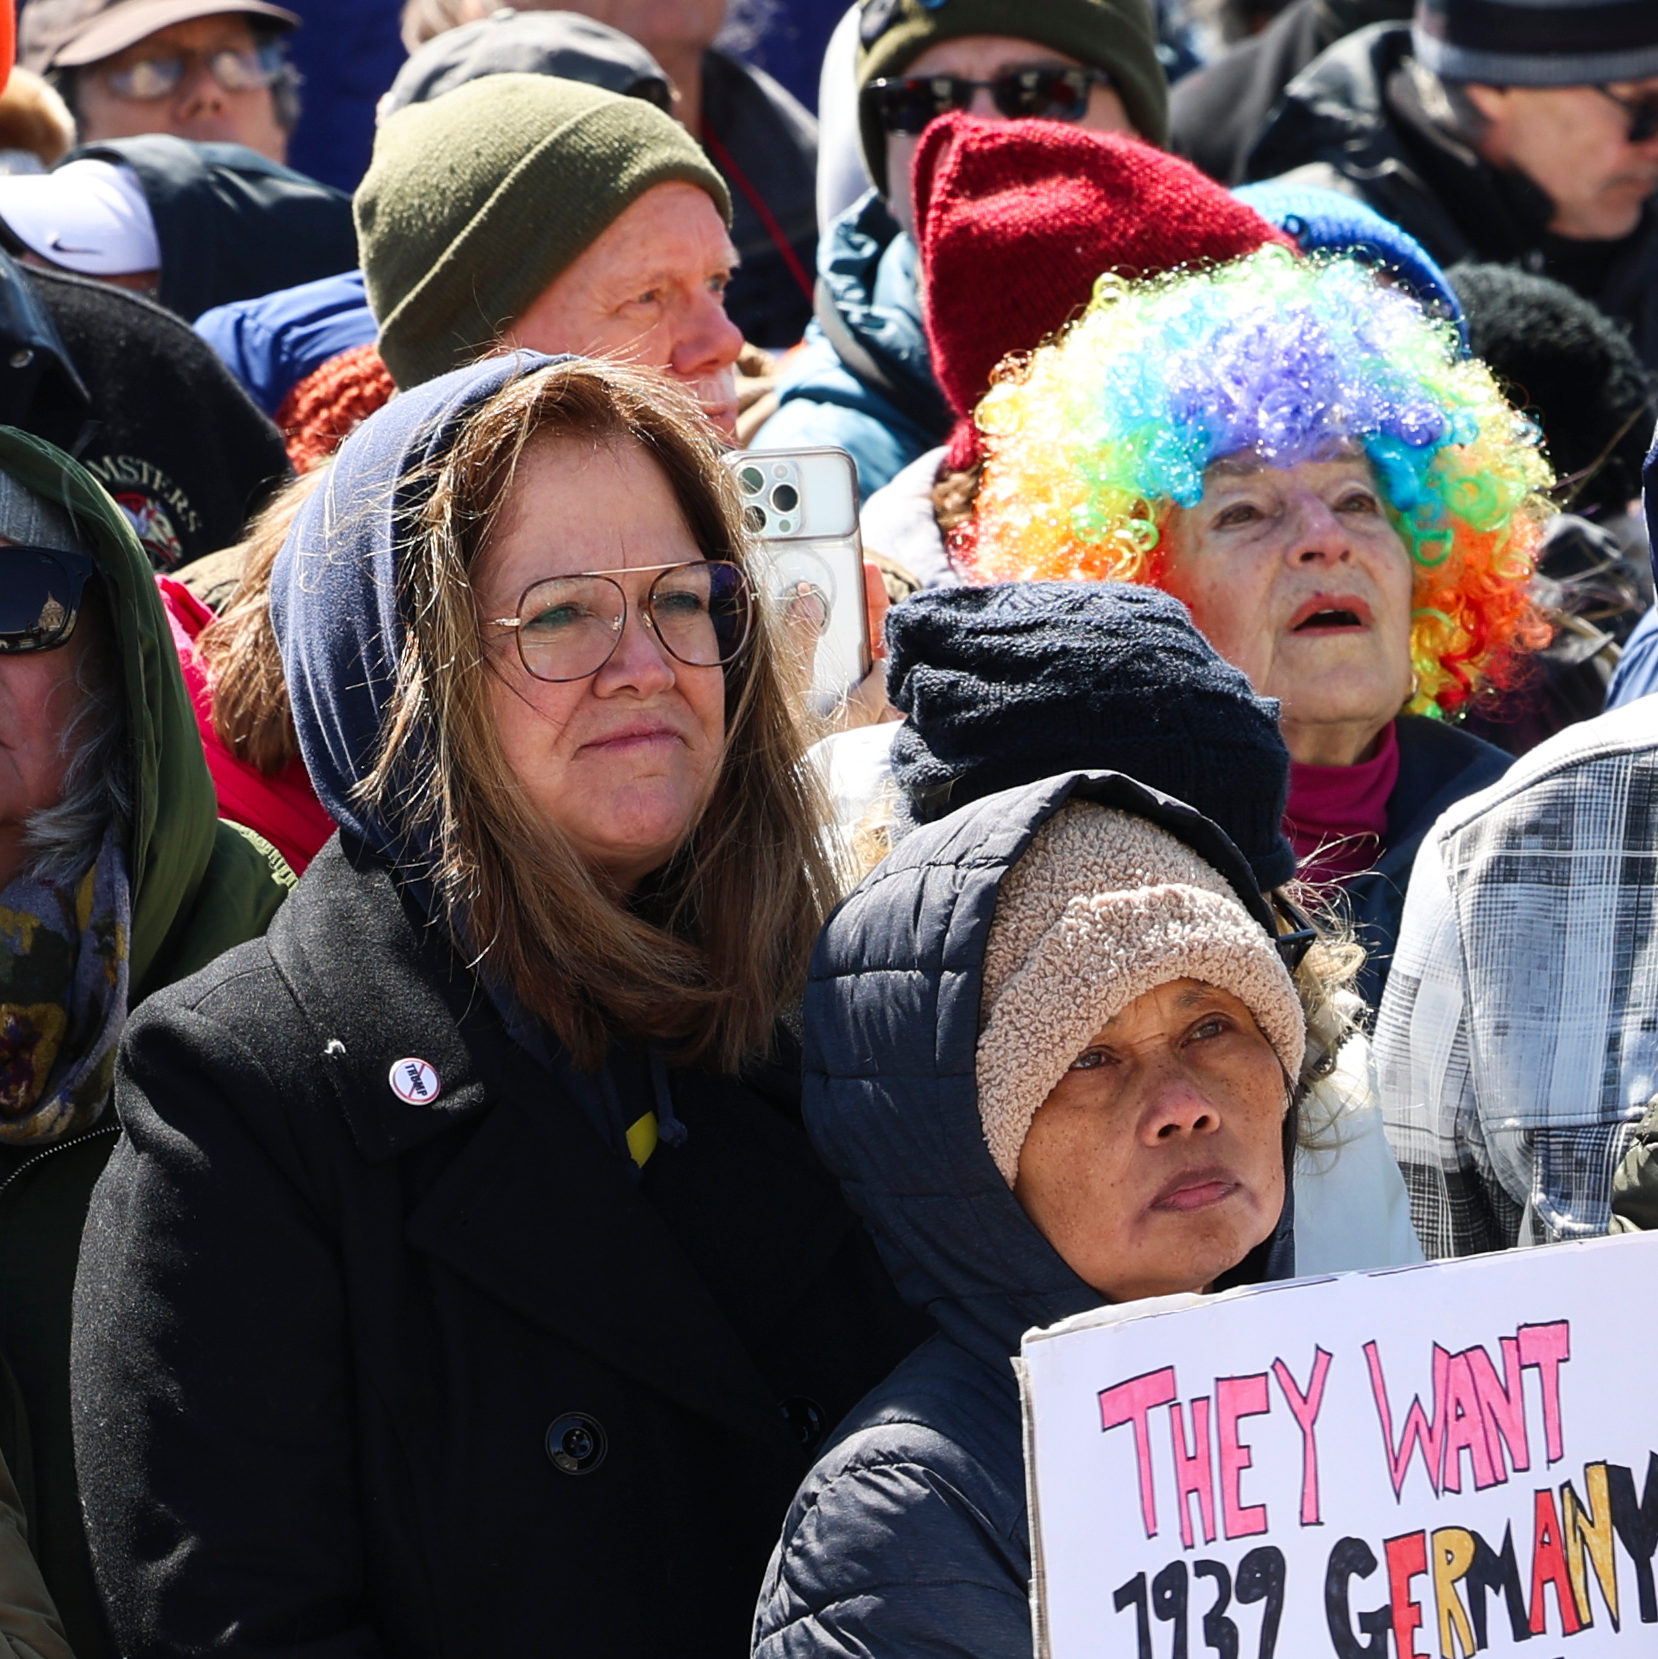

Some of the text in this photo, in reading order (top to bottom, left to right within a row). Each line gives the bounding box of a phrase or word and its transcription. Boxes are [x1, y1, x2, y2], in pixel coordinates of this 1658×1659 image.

[405, 1063, 428, 1096] TRUMP
[1098, 1320, 1570, 1551] THEY WANT
[1112, 1545, 1288, 1659] 1939
